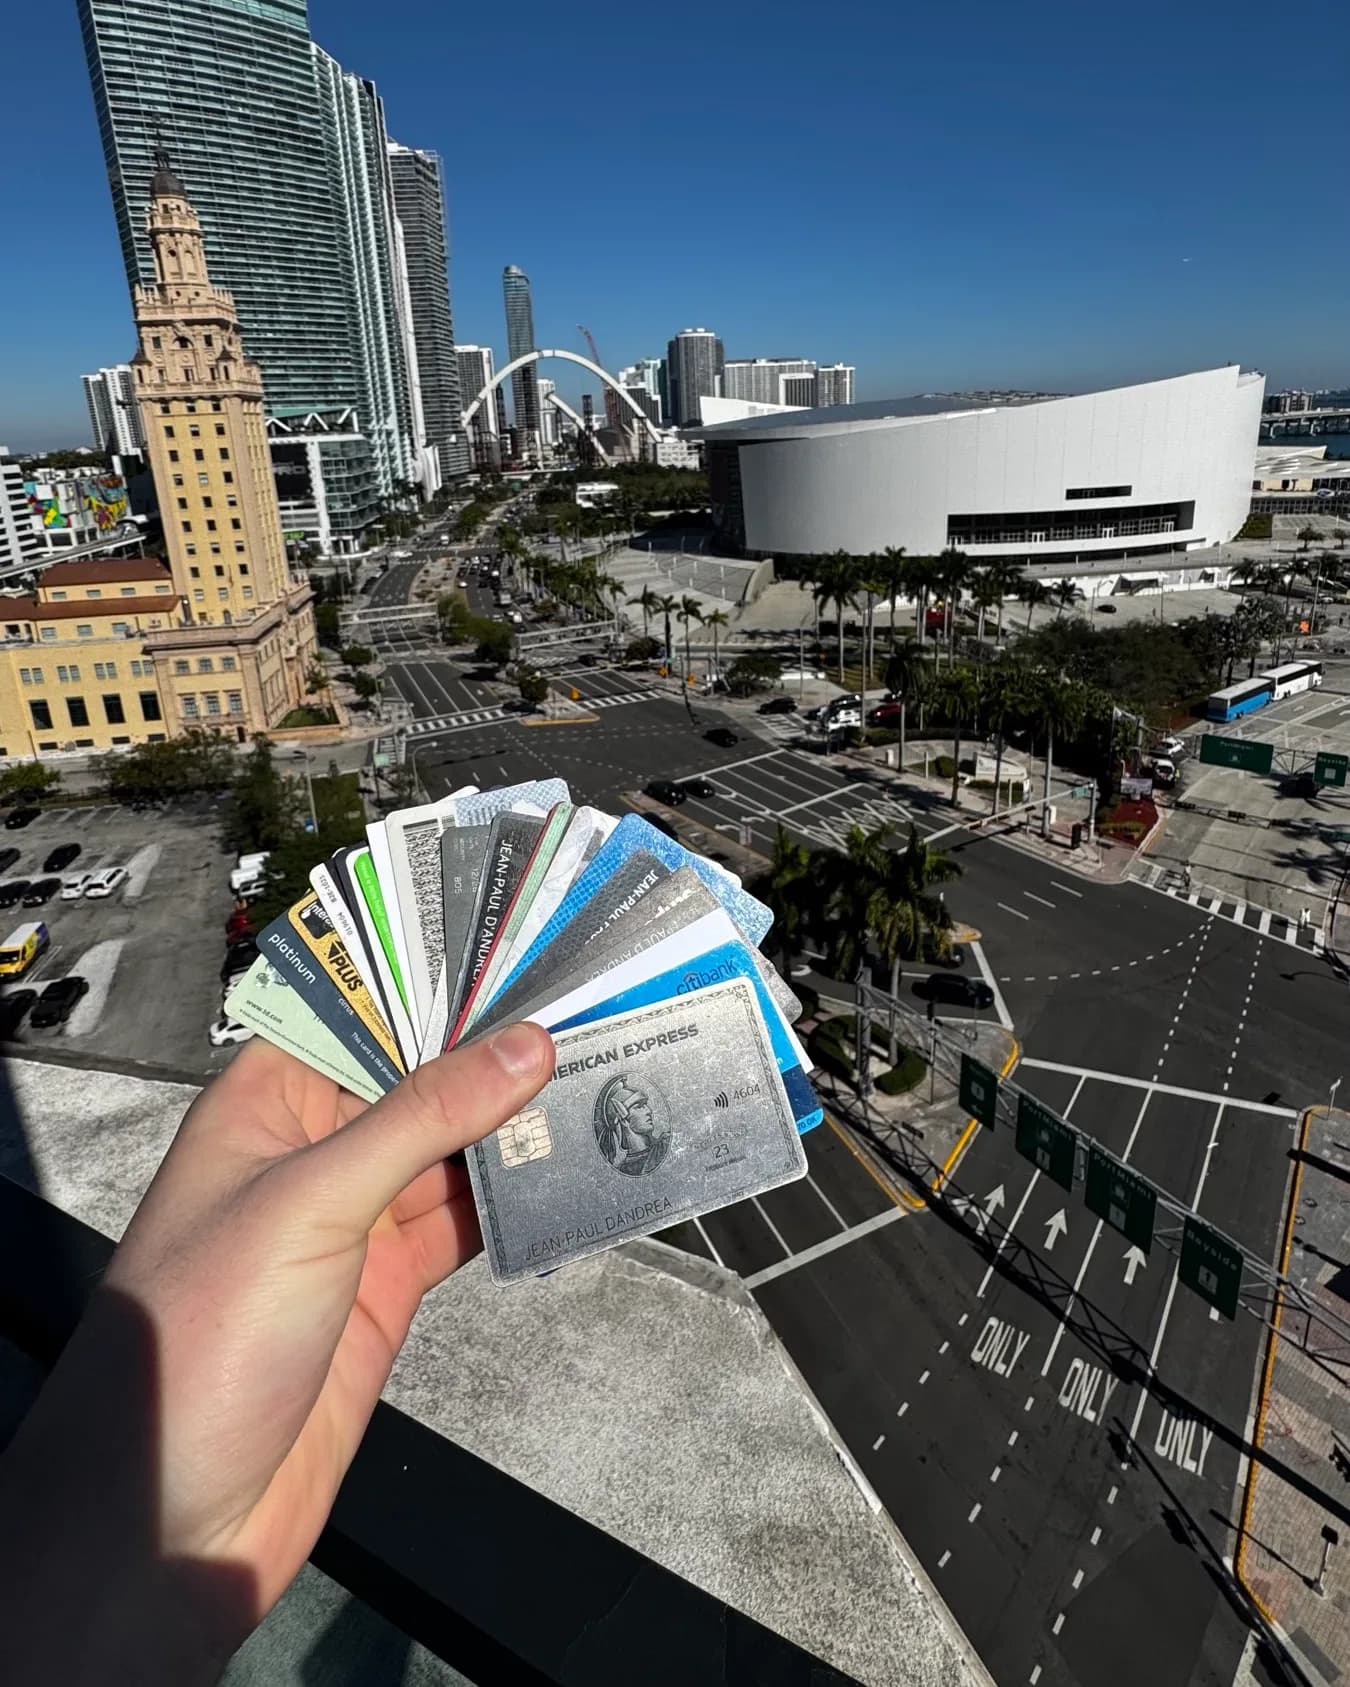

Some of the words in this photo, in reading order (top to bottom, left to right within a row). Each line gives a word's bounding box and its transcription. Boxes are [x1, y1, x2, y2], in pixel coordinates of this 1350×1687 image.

[453, 876, 463, 894] 805
[486, 839, 513, 912] JEAN-PAUL
[608, 869, 660, 921] JEAN-PAUL
[268, 933, 316, 984] platinum
[329, 956, 364, 991] PLUS
[471, 916, 498, 986] D'ANDRE
[676, 957, 738, 996] citibank
[338, 998, 354, 1016] cirrus
[360, 1042, 371, 1055] card
[551, 1048, 619, 1081] ERICAN
[623, 1024, 699, 1058] EXPRESS
[733, 1083, 761, 1100] 4604
[714, 1144, 730, 1158] 23
[1186, 1228, 1238, 1271] Bayside
[970, 1315, 1031, 1379] ONLY
[1058, 1357, 1120, 1427] ONLY
[1154, 1408, 1214, 1477] ONLY
